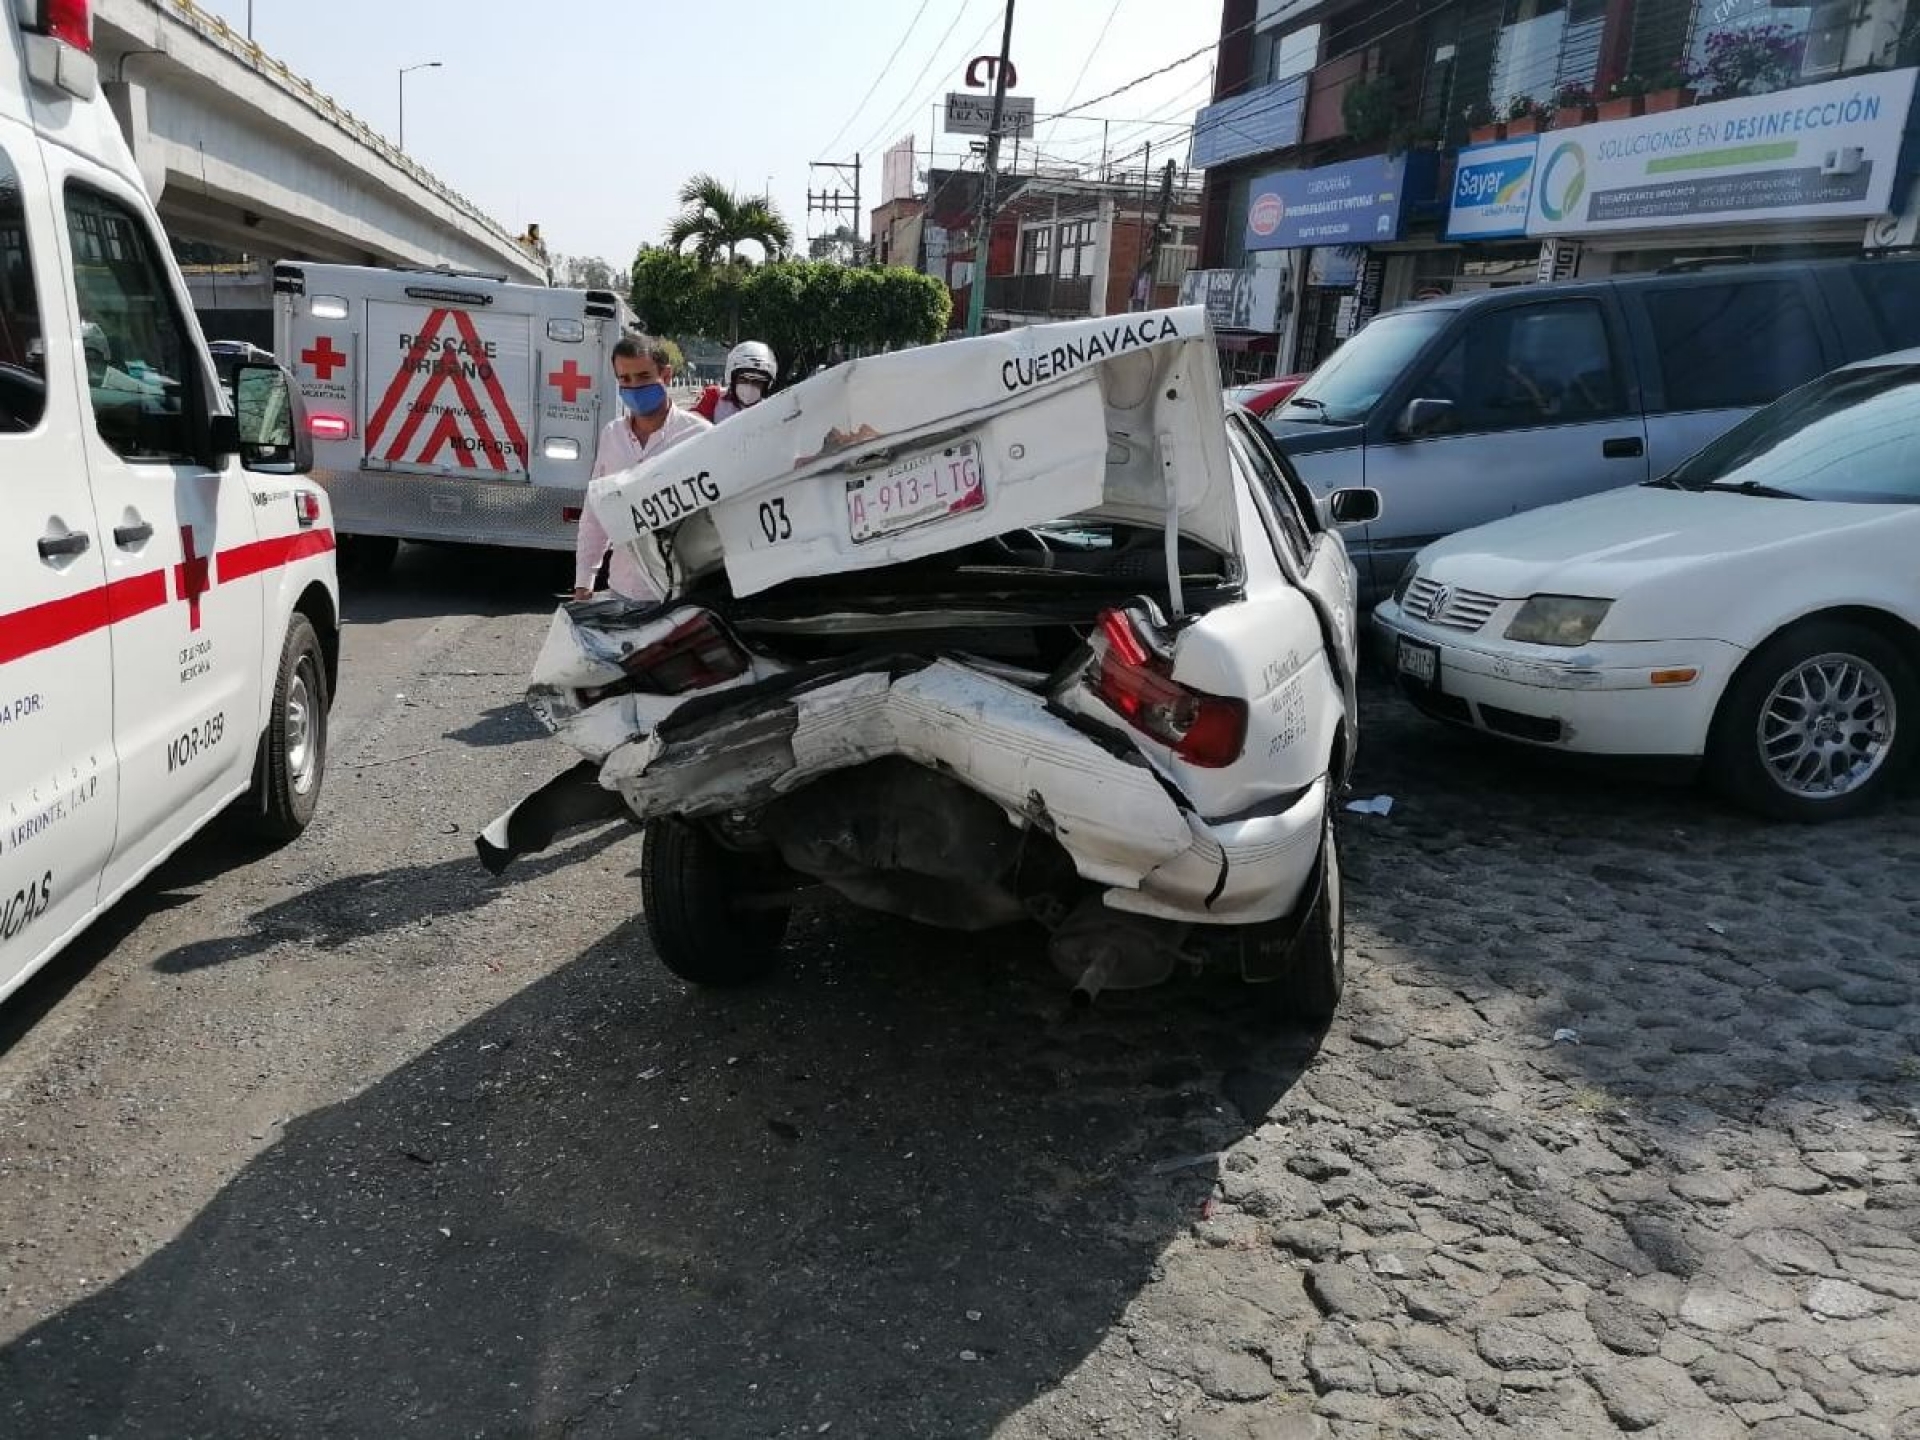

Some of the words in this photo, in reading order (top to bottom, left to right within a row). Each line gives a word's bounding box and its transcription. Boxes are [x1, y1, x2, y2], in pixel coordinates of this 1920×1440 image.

[1597, 125, 1692, 161] SOLUCIONES
[1698, 120, 1719, 144] EN
[1723, 91, 1882, 142] DESINFECCIÓN
[1459, 168, 1505, 201] Sayer
[399, 333, 497, 358] RESCATE
[403, 357, 493, 380] URBANO
[1002, 316, 1179, 392] CUERNAVACA
[630, 470, 721, 535] A913LTG
[853, 457, 977, 525] A-913-LTG
[759, 498, 793, 544] 03
[15, 693, 45, 720] POR:
[167, 711, 225, 773] MOR-059
[9, 800, 67, 850] ARRONTE,
[0, 869, 52, 941] ICAS
